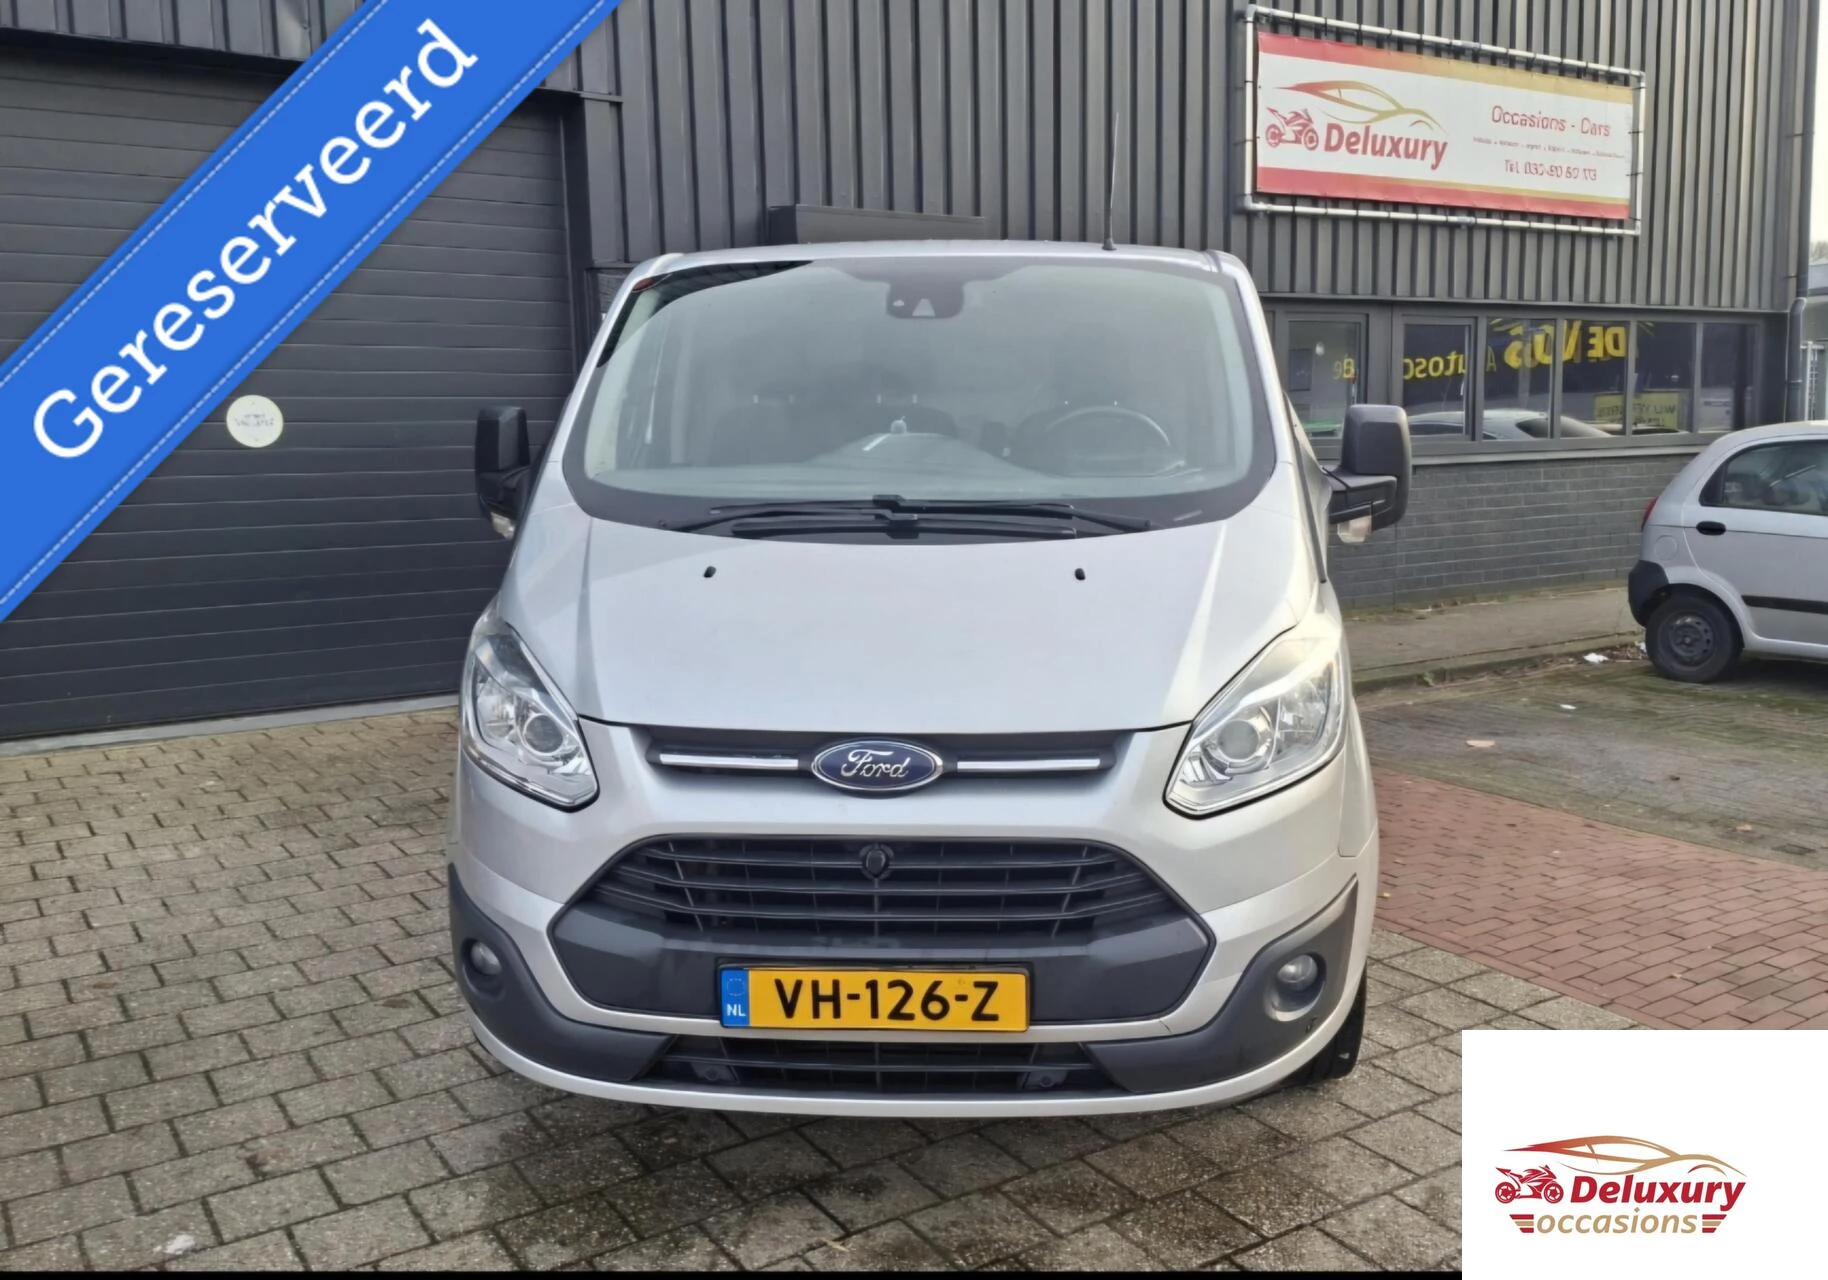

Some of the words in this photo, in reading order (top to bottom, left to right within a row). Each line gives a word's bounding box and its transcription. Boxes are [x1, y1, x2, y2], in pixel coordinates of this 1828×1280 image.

[1492, 105, 1567, 132] Occasions
[1581, 117, 1611, 137] Cars
[1324, 122, 1448, 169] Deluxury
[841, 749, 911, 778] Ford
[726, 1003, 746, 1017] NL
[774, 979, 999, 1022] VH-126-Z
